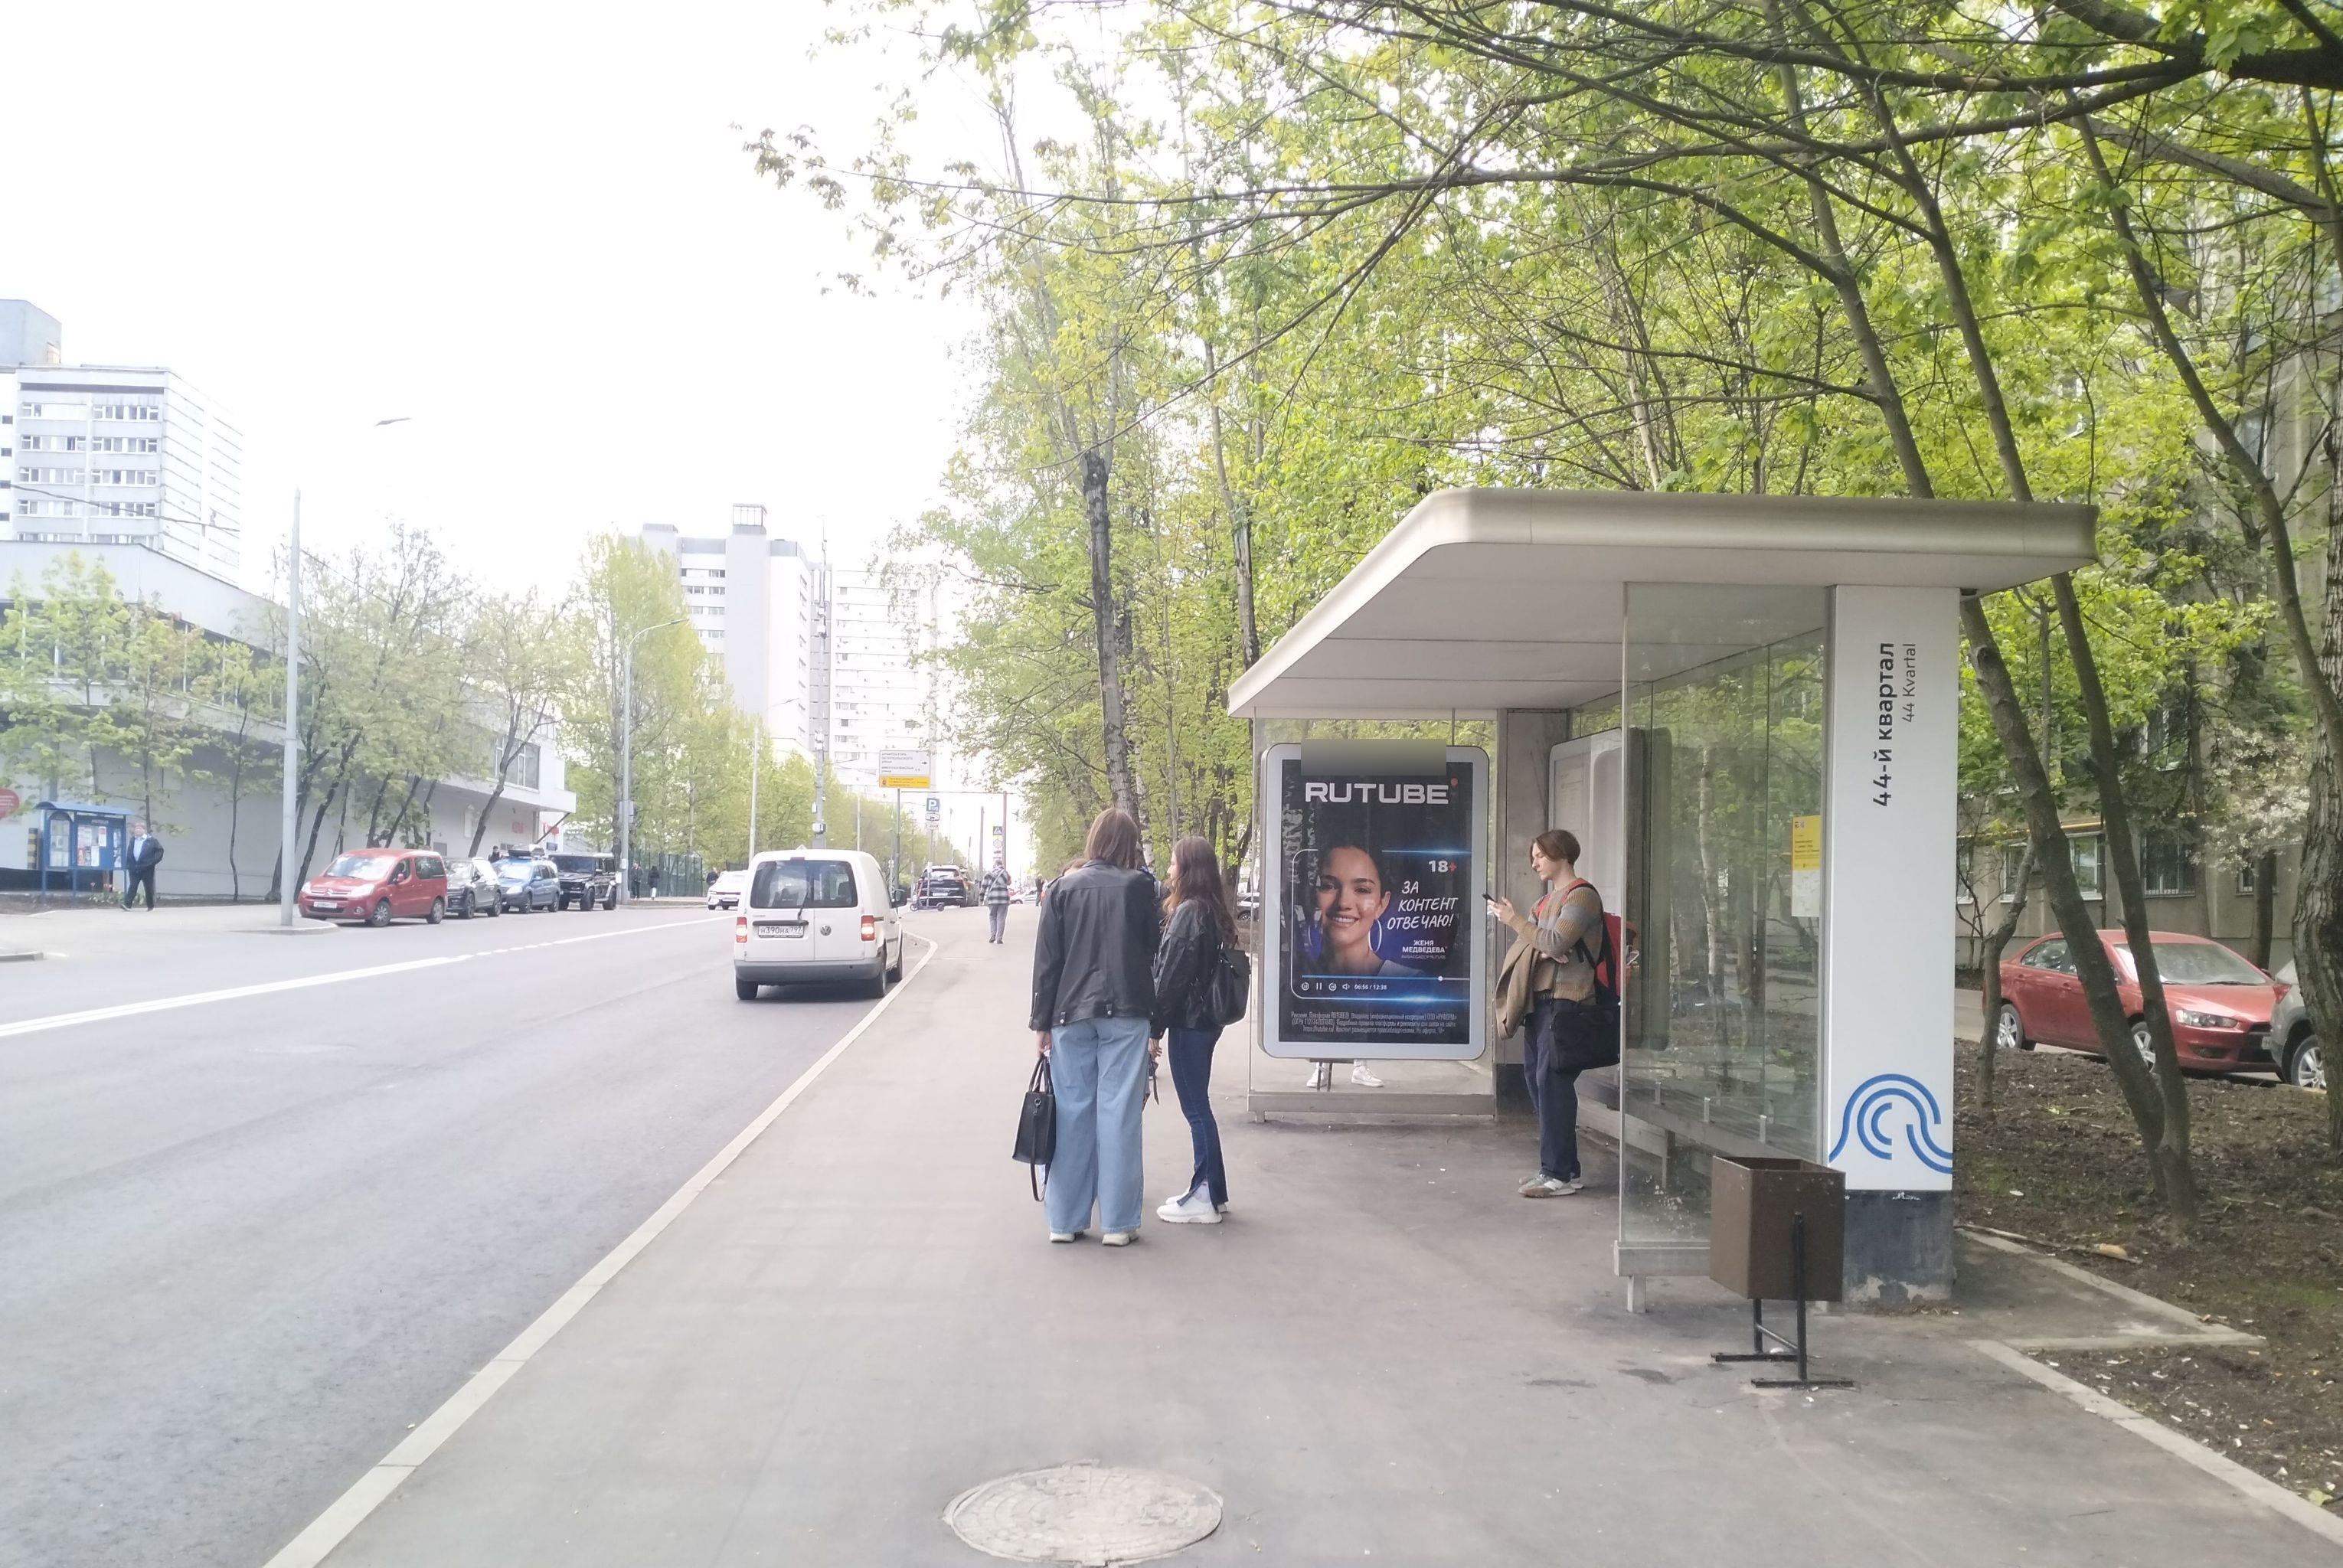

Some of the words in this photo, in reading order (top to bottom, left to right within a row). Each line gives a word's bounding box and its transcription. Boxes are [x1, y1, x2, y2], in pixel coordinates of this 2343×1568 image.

[1902, 643, 1916, 697] Kvartal
[1878, 642, 1897, 740] квартал
[1902, 702, 1915, 723] 44
[1873, 749, 1892, 806] 44-й
[1305, 782, 1449, 805] RUTUBE
[1401, 880, 1420, 894] ЗА
[1397, 897, 1459, 913] КОНТЕНТ
[1387, 913, 1454, 929] ОТВЕЧАЮ!
